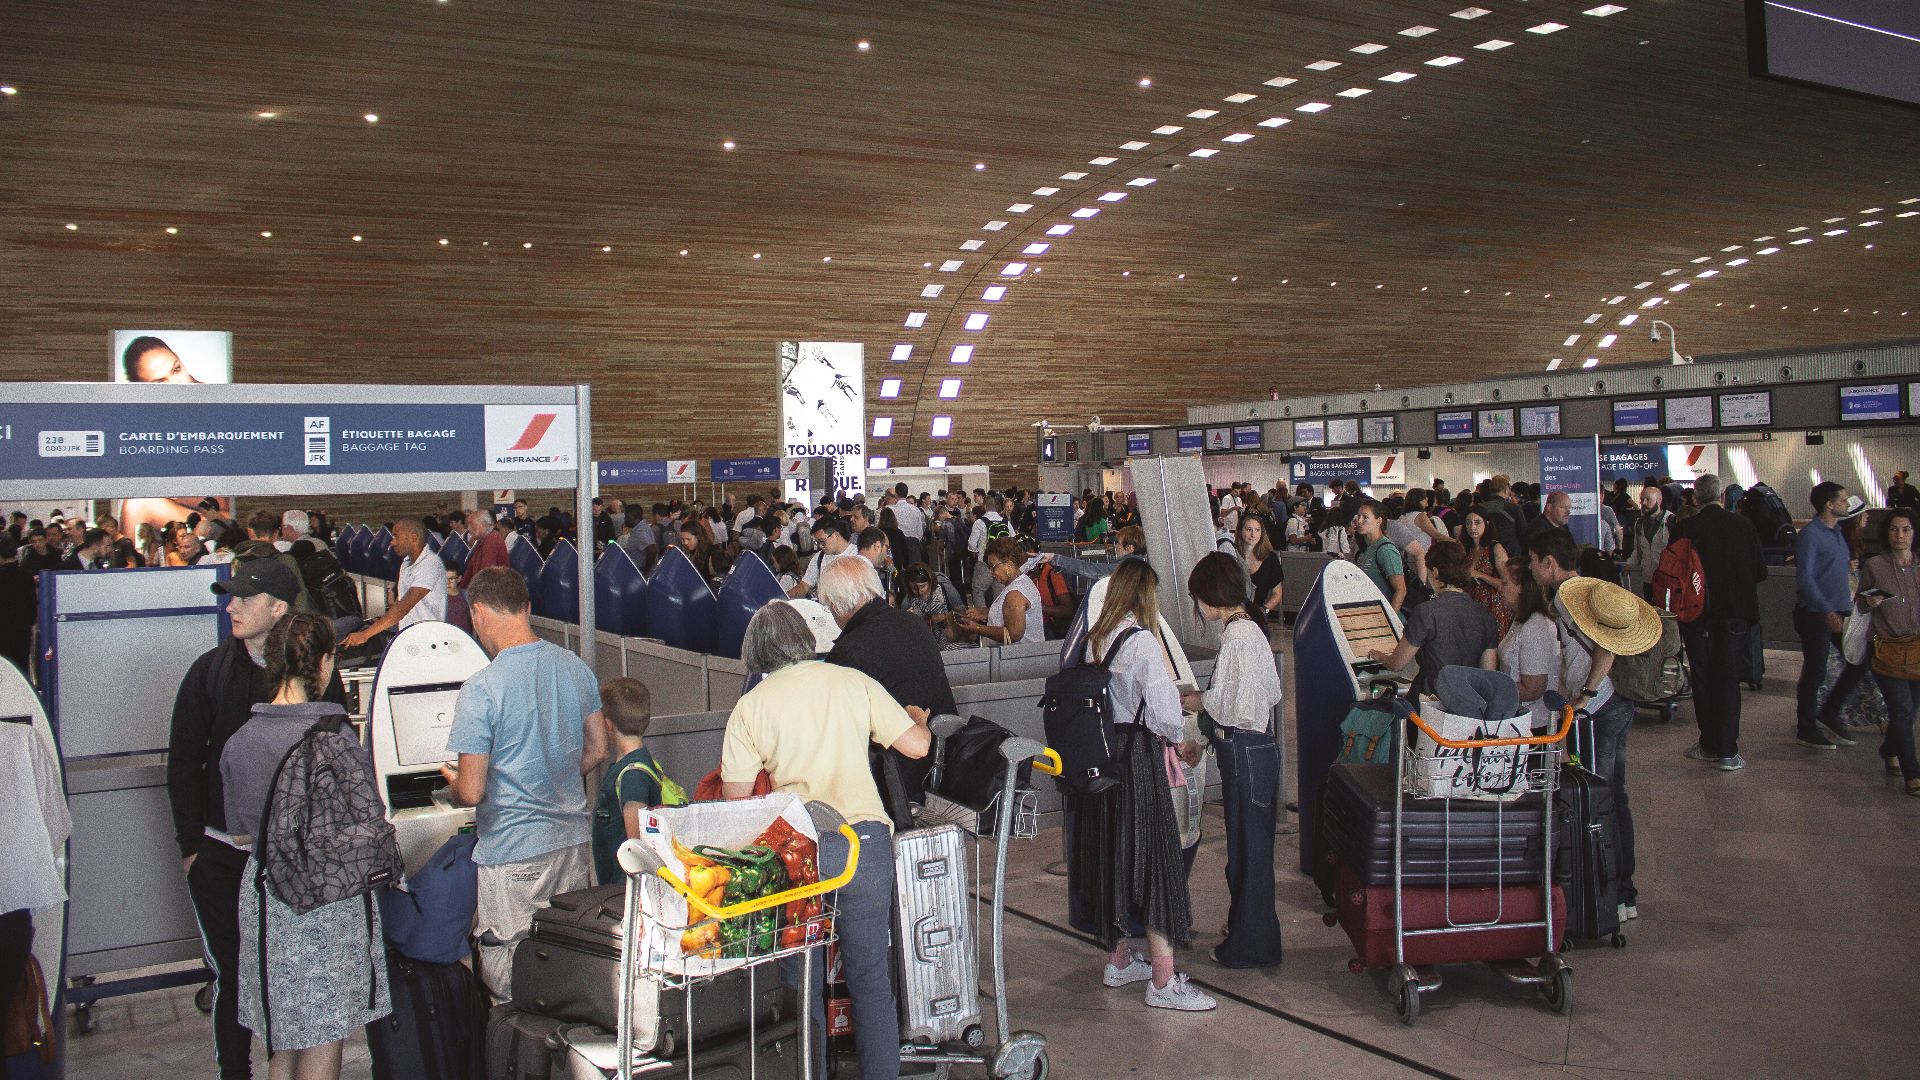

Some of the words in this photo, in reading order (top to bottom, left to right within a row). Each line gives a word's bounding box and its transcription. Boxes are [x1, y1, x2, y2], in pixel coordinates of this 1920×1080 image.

[309, 420, 325, 429] AF
[0, 425, 11, 440] I
[119, 432, 162, 441] CARTE
[166, 431, 285, 441] D'EMBARQUEMENT
[342, 428, 404, 439] ÉTIQUETTE
[407, 429, 456, 438] BAGAGE
[45, 436, 65, 444] 23B
[119, 445, 189, 455] BOARDING
[193, 444, 225, 454] PASS
[342, 442, 400, 452] BAGGAGE
[403, 442, 427, 451] TAG
[788, 444, 861, 456] TOUJOURS
[1045, 443, 1052, 457] 4
[309, 454, 326, 463] JFK
[495, 455, 551, 464] AIRFRANCE
[1609, 453, 1648, 462] BAGAGES
[1309, 462, 1330, 470] DÉPOSE
[1618, 462, 1659, 471] DROP-OFF
[1544, 473, 1557, 481] des
